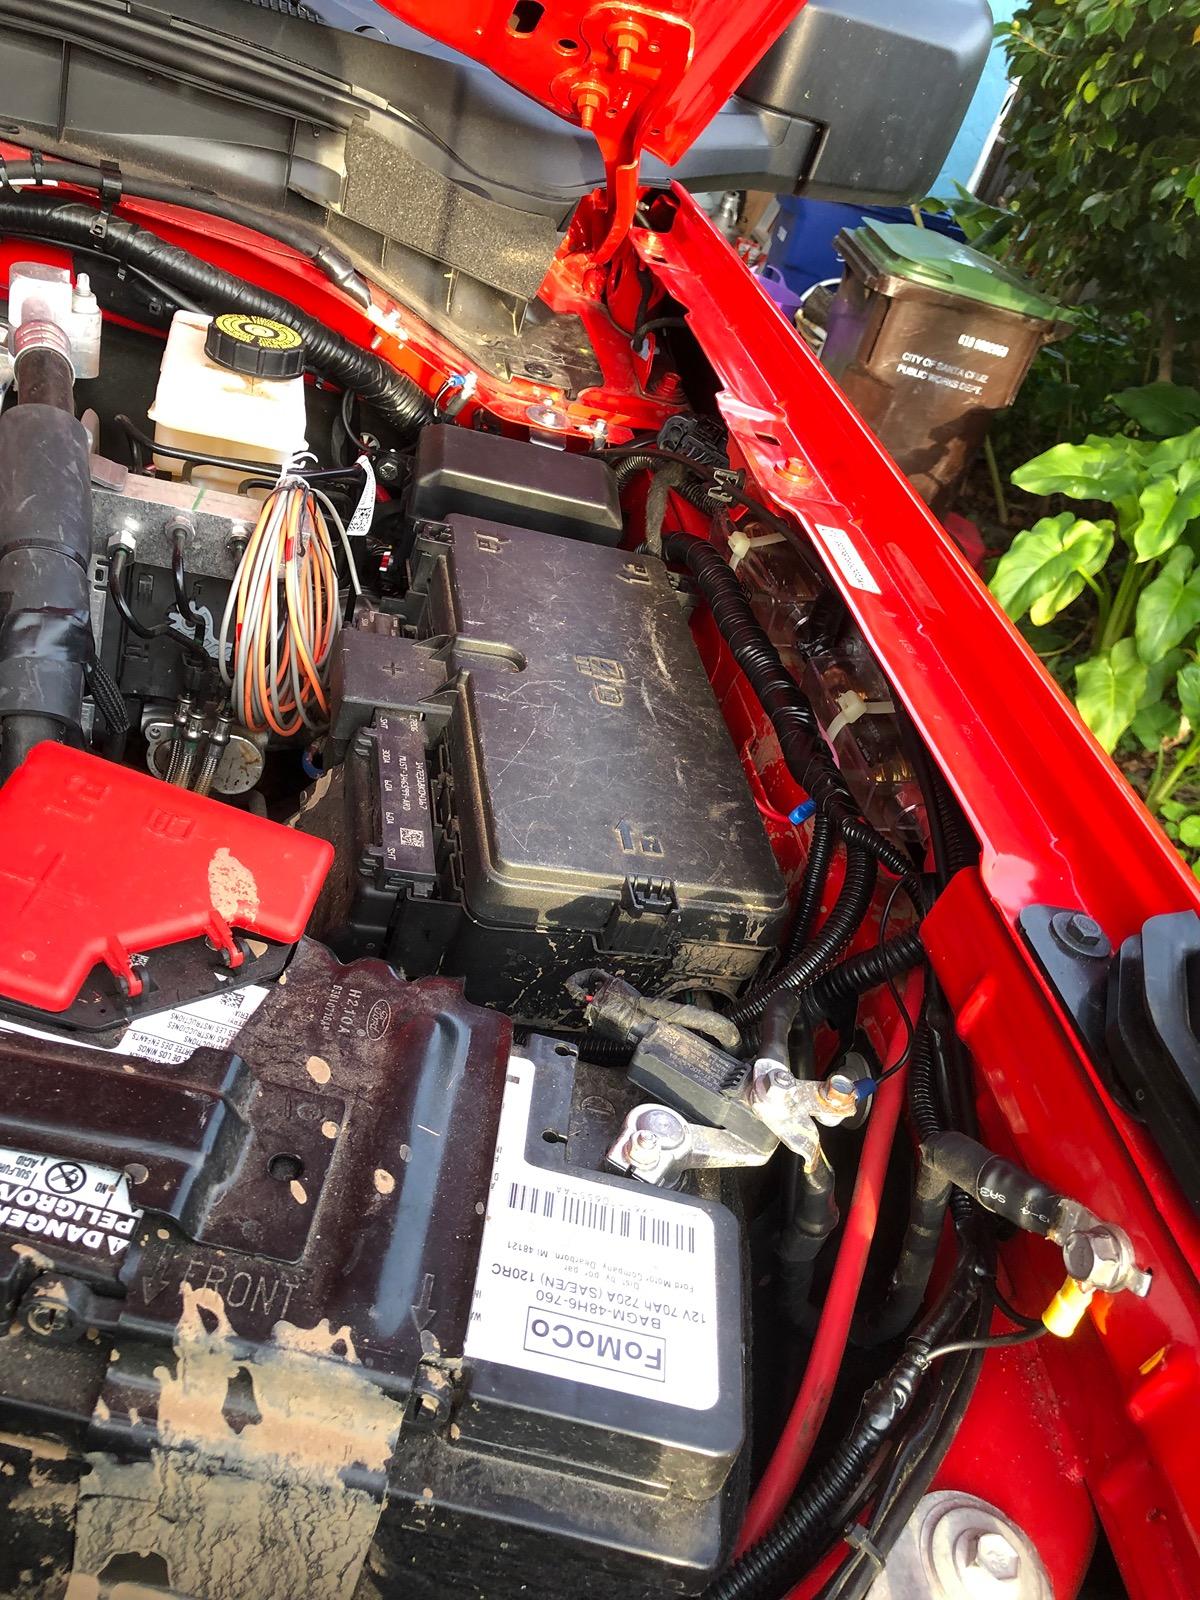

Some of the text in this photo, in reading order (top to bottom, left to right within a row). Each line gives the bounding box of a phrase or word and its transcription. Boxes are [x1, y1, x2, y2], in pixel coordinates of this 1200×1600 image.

[896, 364, 928, 380] PUBLIC
[902, 352, 924, 364] CITY
[922, 357, 936, 367] OF
[936, 362, 965, 376] SANTA
[16, 1155, 39, 1169] ACID
[95, 1182, 108, 1194] NO
[507, 1241, 533, 1254] 48121
[184, 1259, 301, 1319] FRONT
[491, 1263, 706, 1324] 12V 70Ah 720A (SAE/EN) 120RC
[536, 1289, 661, 1330] BAGM-48H6-760
[531, 1318, 662, 1371] FoMoCo
